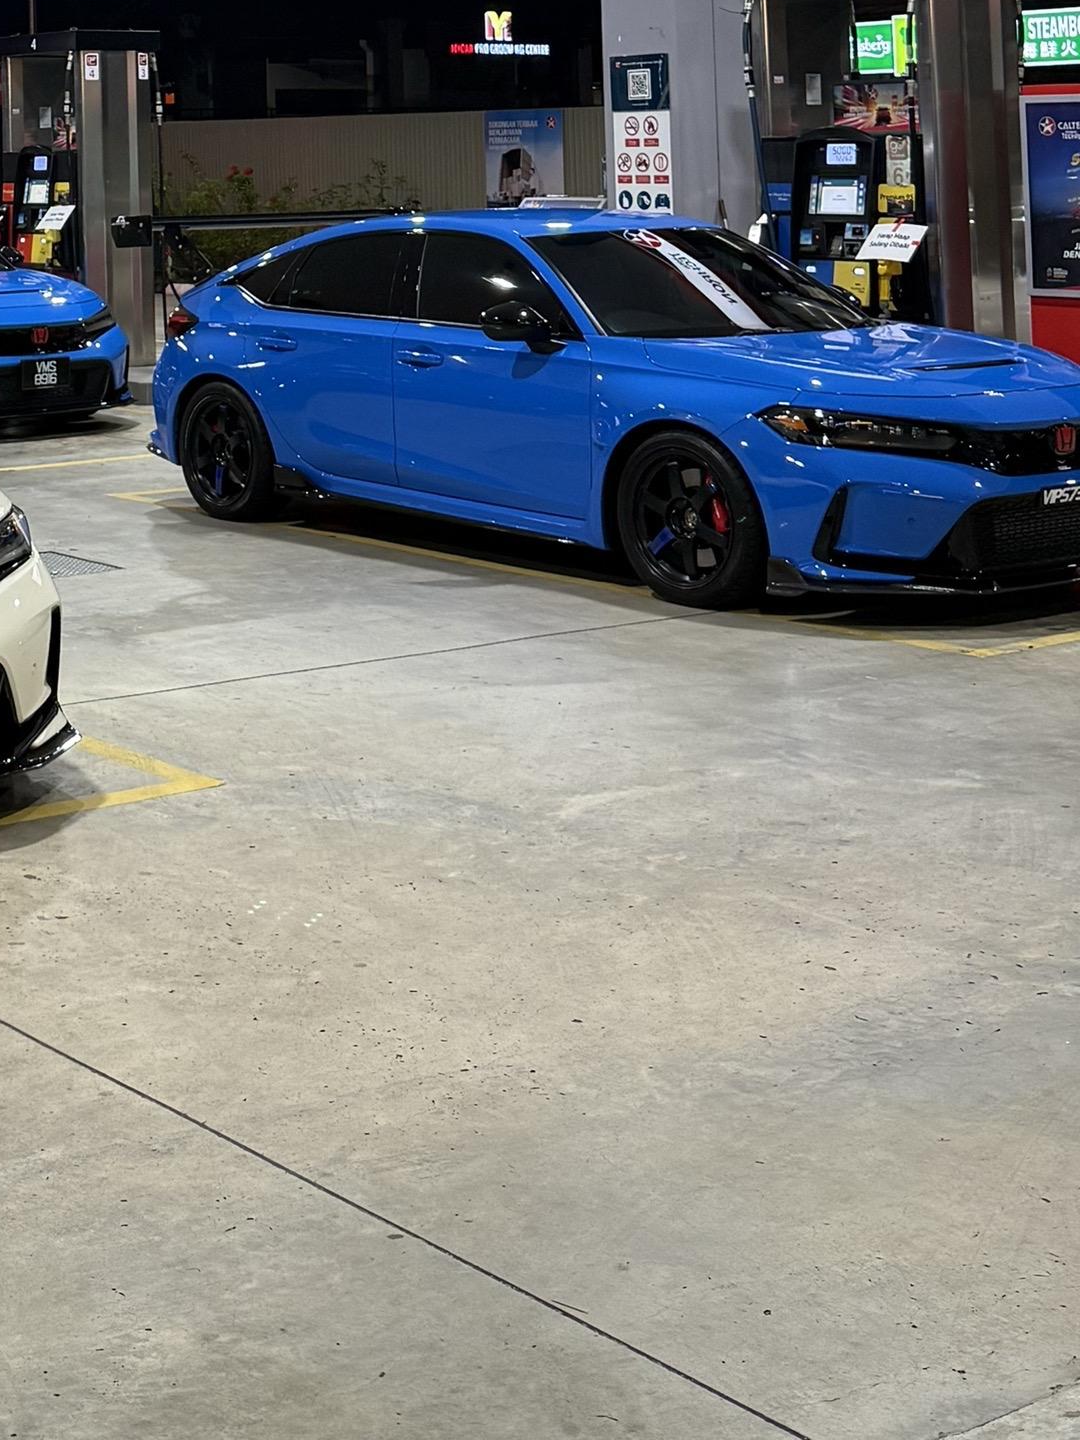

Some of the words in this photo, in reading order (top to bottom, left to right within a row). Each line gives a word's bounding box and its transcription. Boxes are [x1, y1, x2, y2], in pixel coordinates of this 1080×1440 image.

[1027, 15, 1080, 40] STEAMB
[30, 38, 37, 51] 4
[893, 167, 904, 185] 6
[35, 360, 57, 373] VMS
[34, 372, 58, 385] 8916
